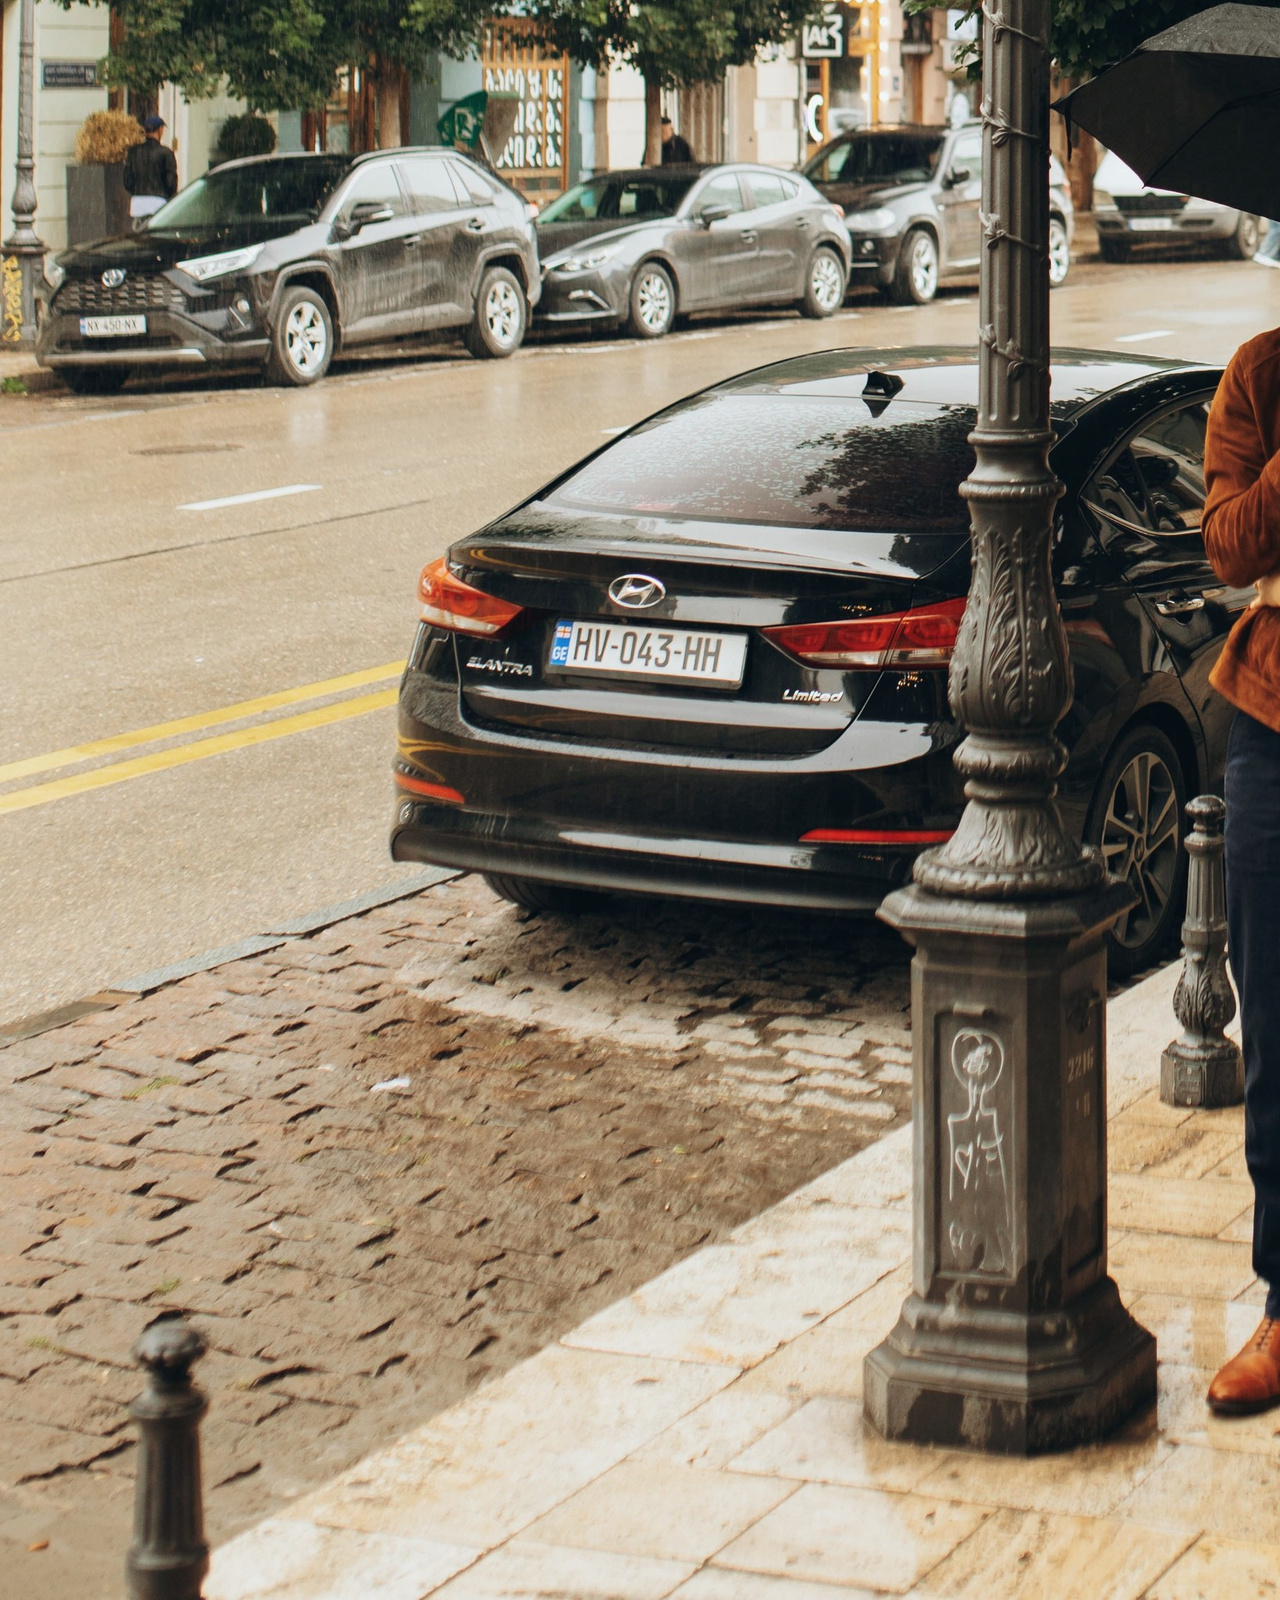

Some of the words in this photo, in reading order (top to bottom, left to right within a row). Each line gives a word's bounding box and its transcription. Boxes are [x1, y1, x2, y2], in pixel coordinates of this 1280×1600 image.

[552, 646, 568, 661] GE
[573, 627, 723, 673] HV-043-HH
[466, 656, 533, 677] ELANTRA
[781, 688, 844, 703] Limited
